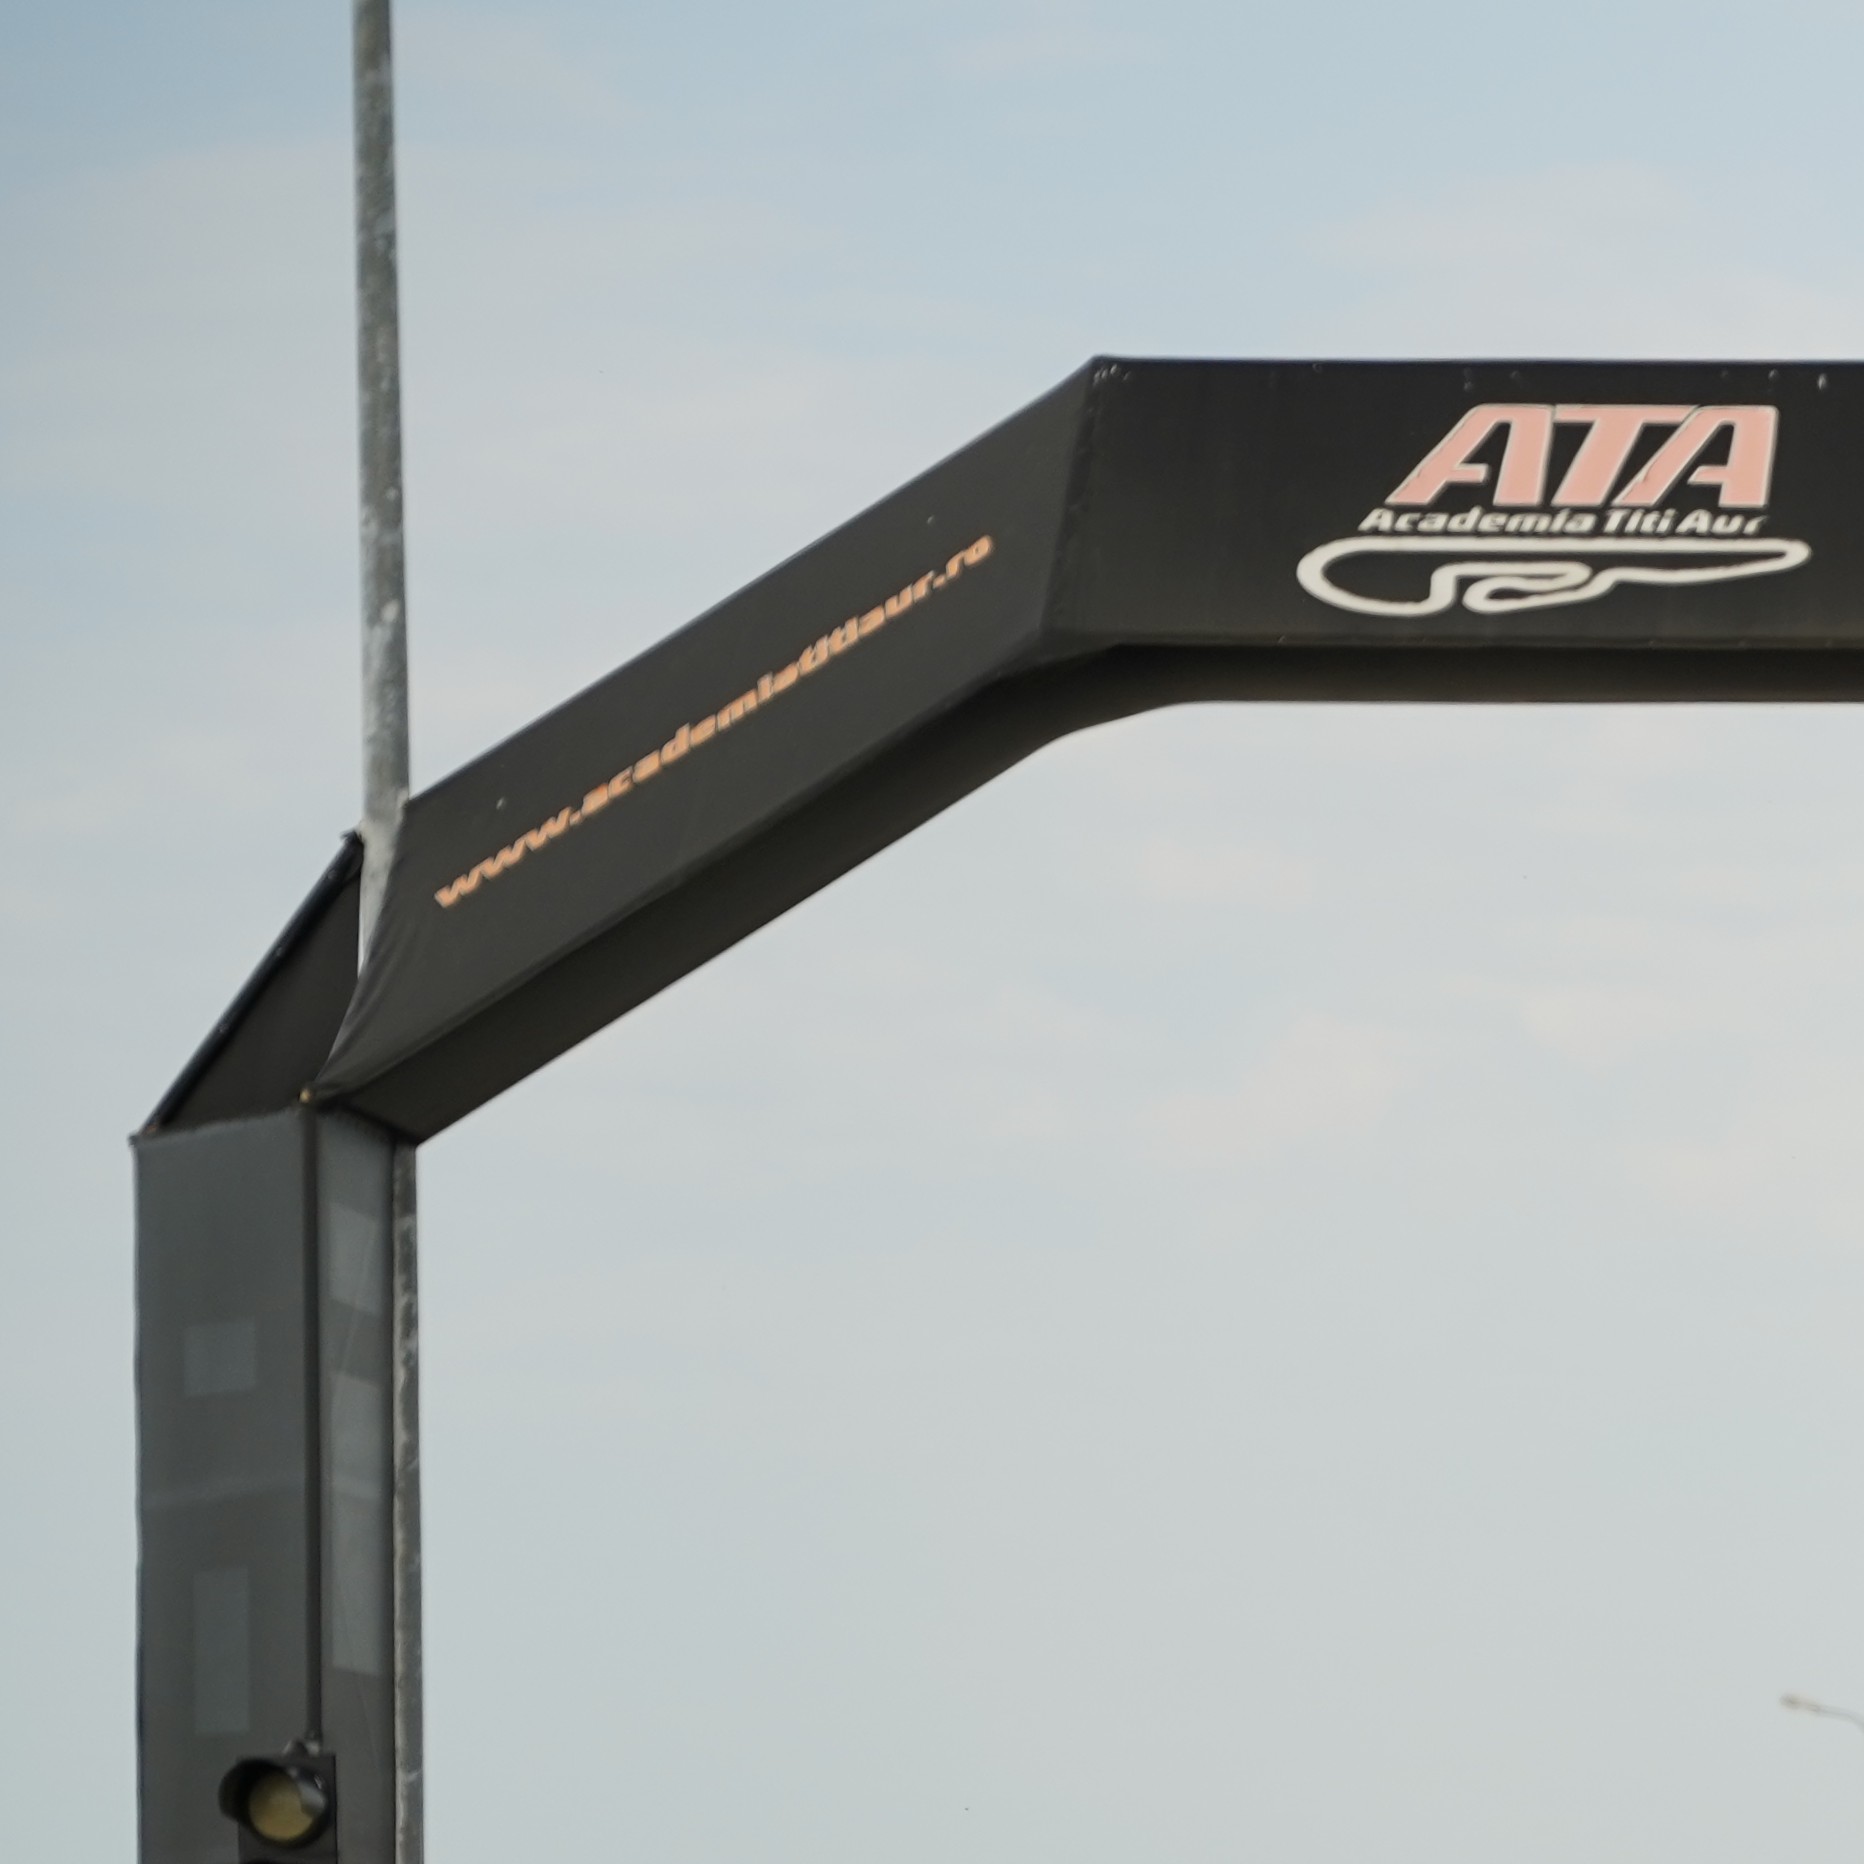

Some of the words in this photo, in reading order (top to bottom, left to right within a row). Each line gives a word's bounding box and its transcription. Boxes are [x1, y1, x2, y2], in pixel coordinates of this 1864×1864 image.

[1384, 403, 1779, 508] ATA
[1358, 506, 1598, 535] Academia
[1603, 508, 1676, 535] Titi
[1674, 509, 1769, 535] Aur
[435, 535, 994, 908] www.academiatitiaur.ro
